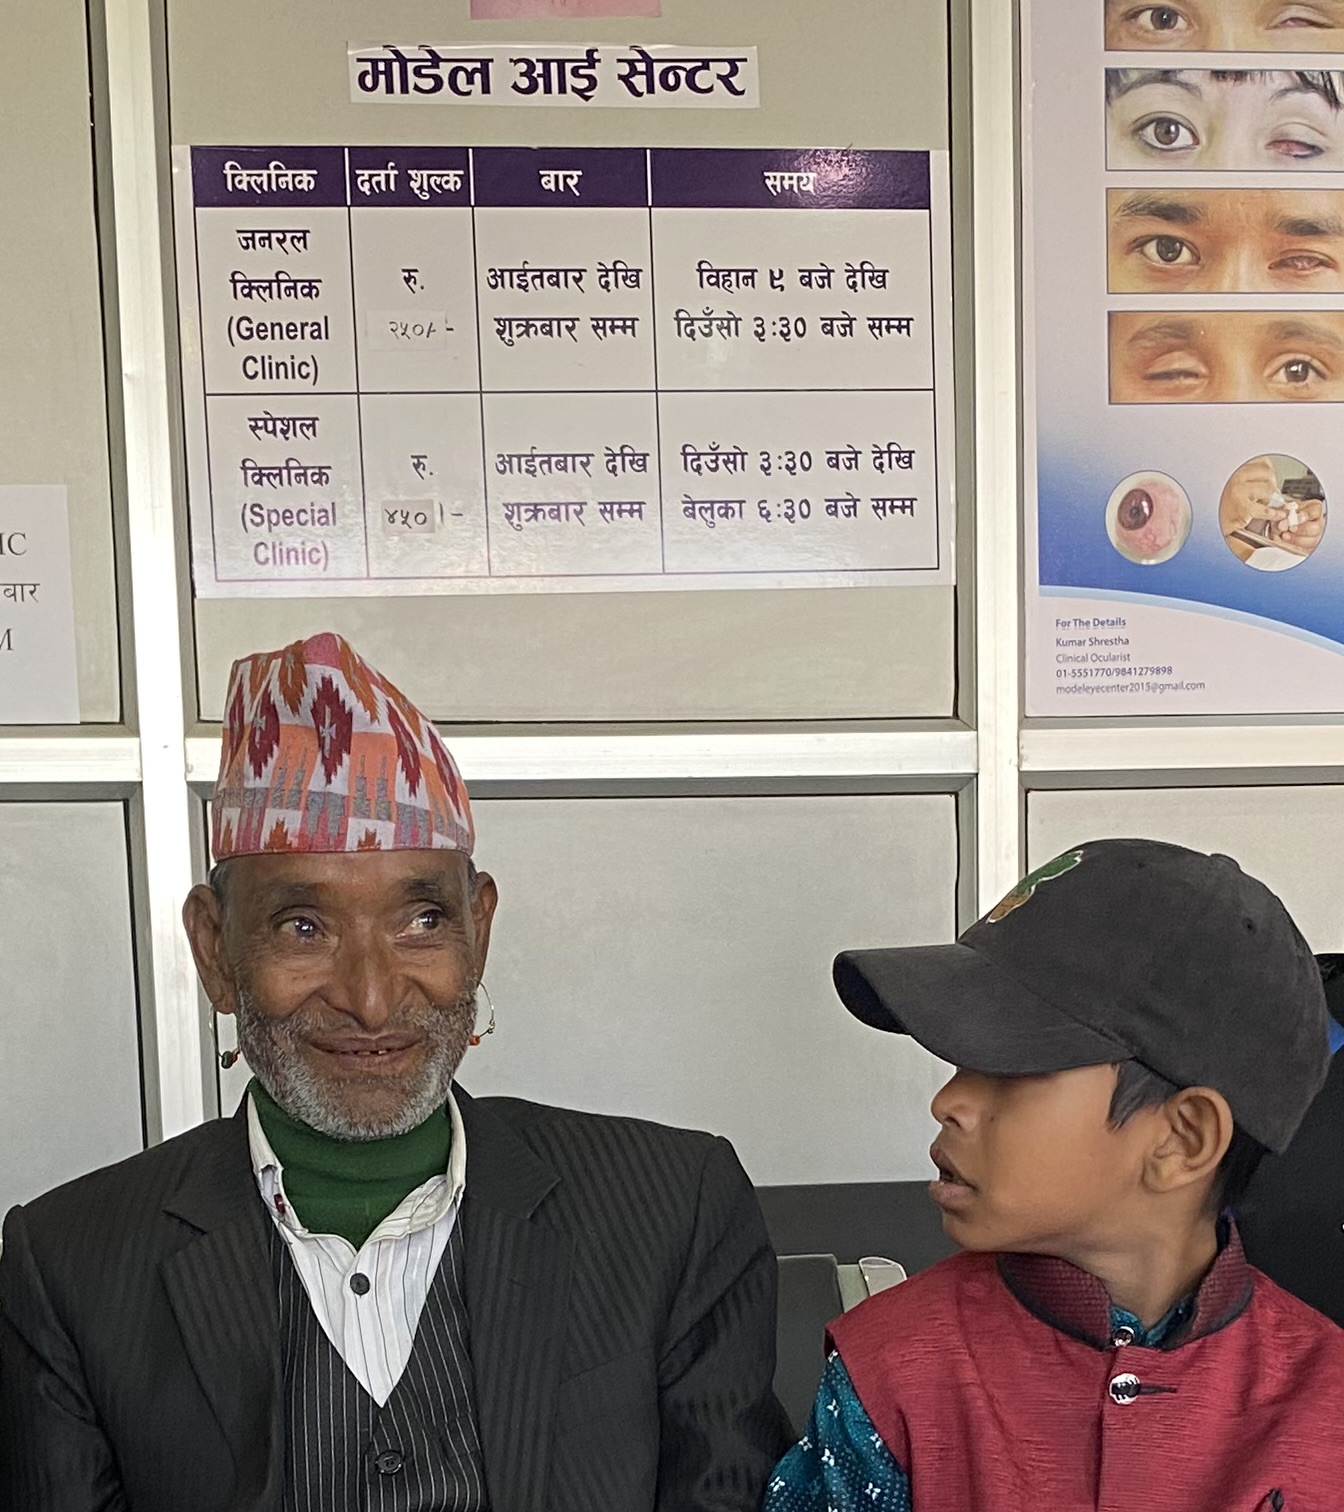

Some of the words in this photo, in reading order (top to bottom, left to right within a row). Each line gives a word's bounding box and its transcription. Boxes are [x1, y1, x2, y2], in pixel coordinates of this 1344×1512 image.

[357, 45, 494, 98] मोडेल
[509, 46, 600, 103] आई
[616, 46, 748, 99] सेन्टर
[223, 160, 318, 195] क्लिनिक
[355, 162, 398, 193] दर्ता
[407, 169, 464, 200] शुल्क
[539, 169, 582, 197] बार
[763, 170, 817, 197] समय
[236, 229, 311, 256] जनरल
[229, 270, 323, 303] क्लिनिक
[486, 261, 585, 295] आईतबार
[597, 260, 642, 294] देखि
[798, 262, 835, 290] बजे
[843, 260, 889, 294] देखि
[227, 315, 330, 347] (General
[494, 316, 580, 347] शुक्रबार
[590, 316, 640, 341] सम्म
[674, 306, 743, 341] दिउँसो
[820, 310, 857, 339] बजे
[866, 316, 915, 341] सम्म
[242, 355, 319, 386] Clinic)
[247, 410, 320, 440] स्पेशल
[241, 458, 332, 490] क्लिनिक
[241, 502, 337, 533] (Special
[253, 541, 329, 572] Clinic)
[1056, 618, 1071, 627] For
[1073, 618, 1090, 627] The
[1092, 617, 1126, 627] Details
[1056, 638, 1086, 647] Kumar
[1088, 636, 1129, 646] Shrestha
[1056, 653, 1088, 663] Clinical
[1090, 652, 1131, 662] Ocularist
